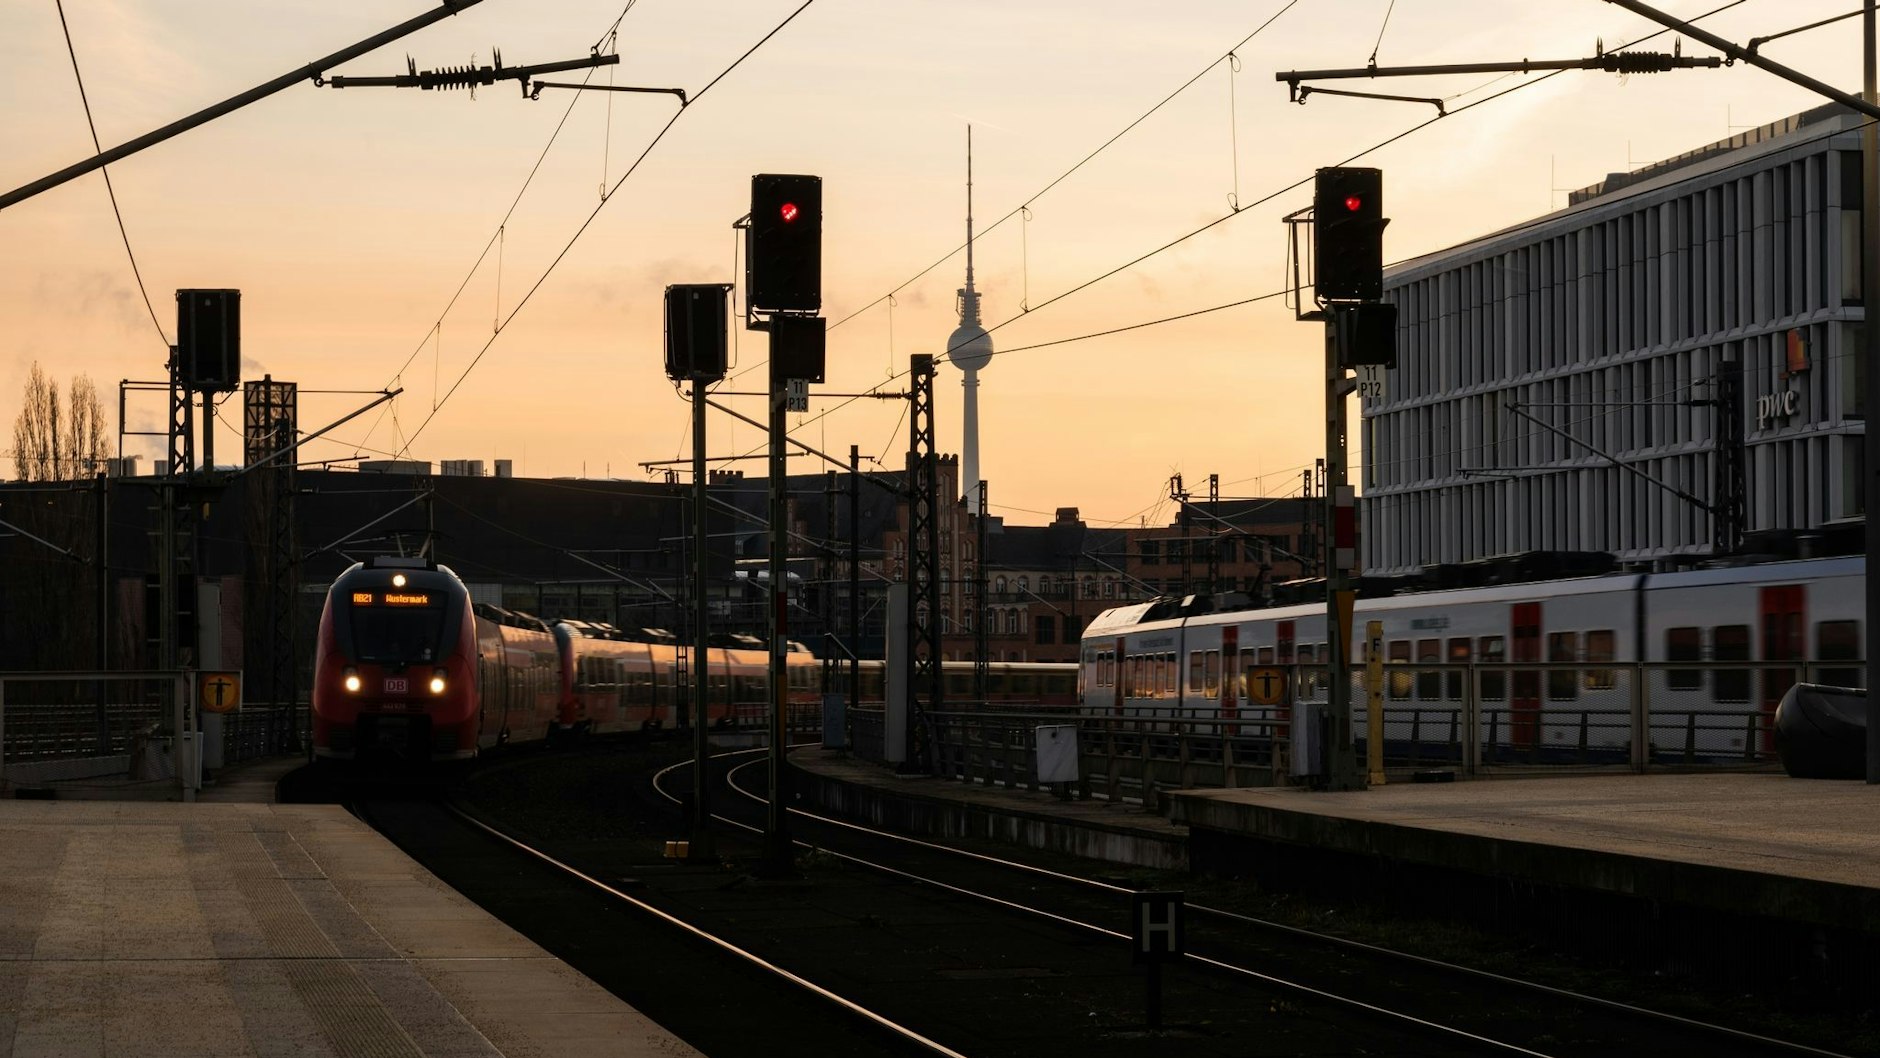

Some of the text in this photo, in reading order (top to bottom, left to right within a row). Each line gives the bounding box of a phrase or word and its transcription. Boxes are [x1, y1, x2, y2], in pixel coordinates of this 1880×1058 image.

[1365, 366, 1376, 381] 11
[794, 381, 803, 394] 11
[1361, 382, 1381, 397] P12
[789, 397, 807, 410] P13
[1755, 389, 1795, 430] pwc
[353, 593, 429, 604] RB21 Wustermark
[1373, 638, 1381, 652] F
[386, 679, 406, 692] DB
[1142, 901, 1175, 953] H
